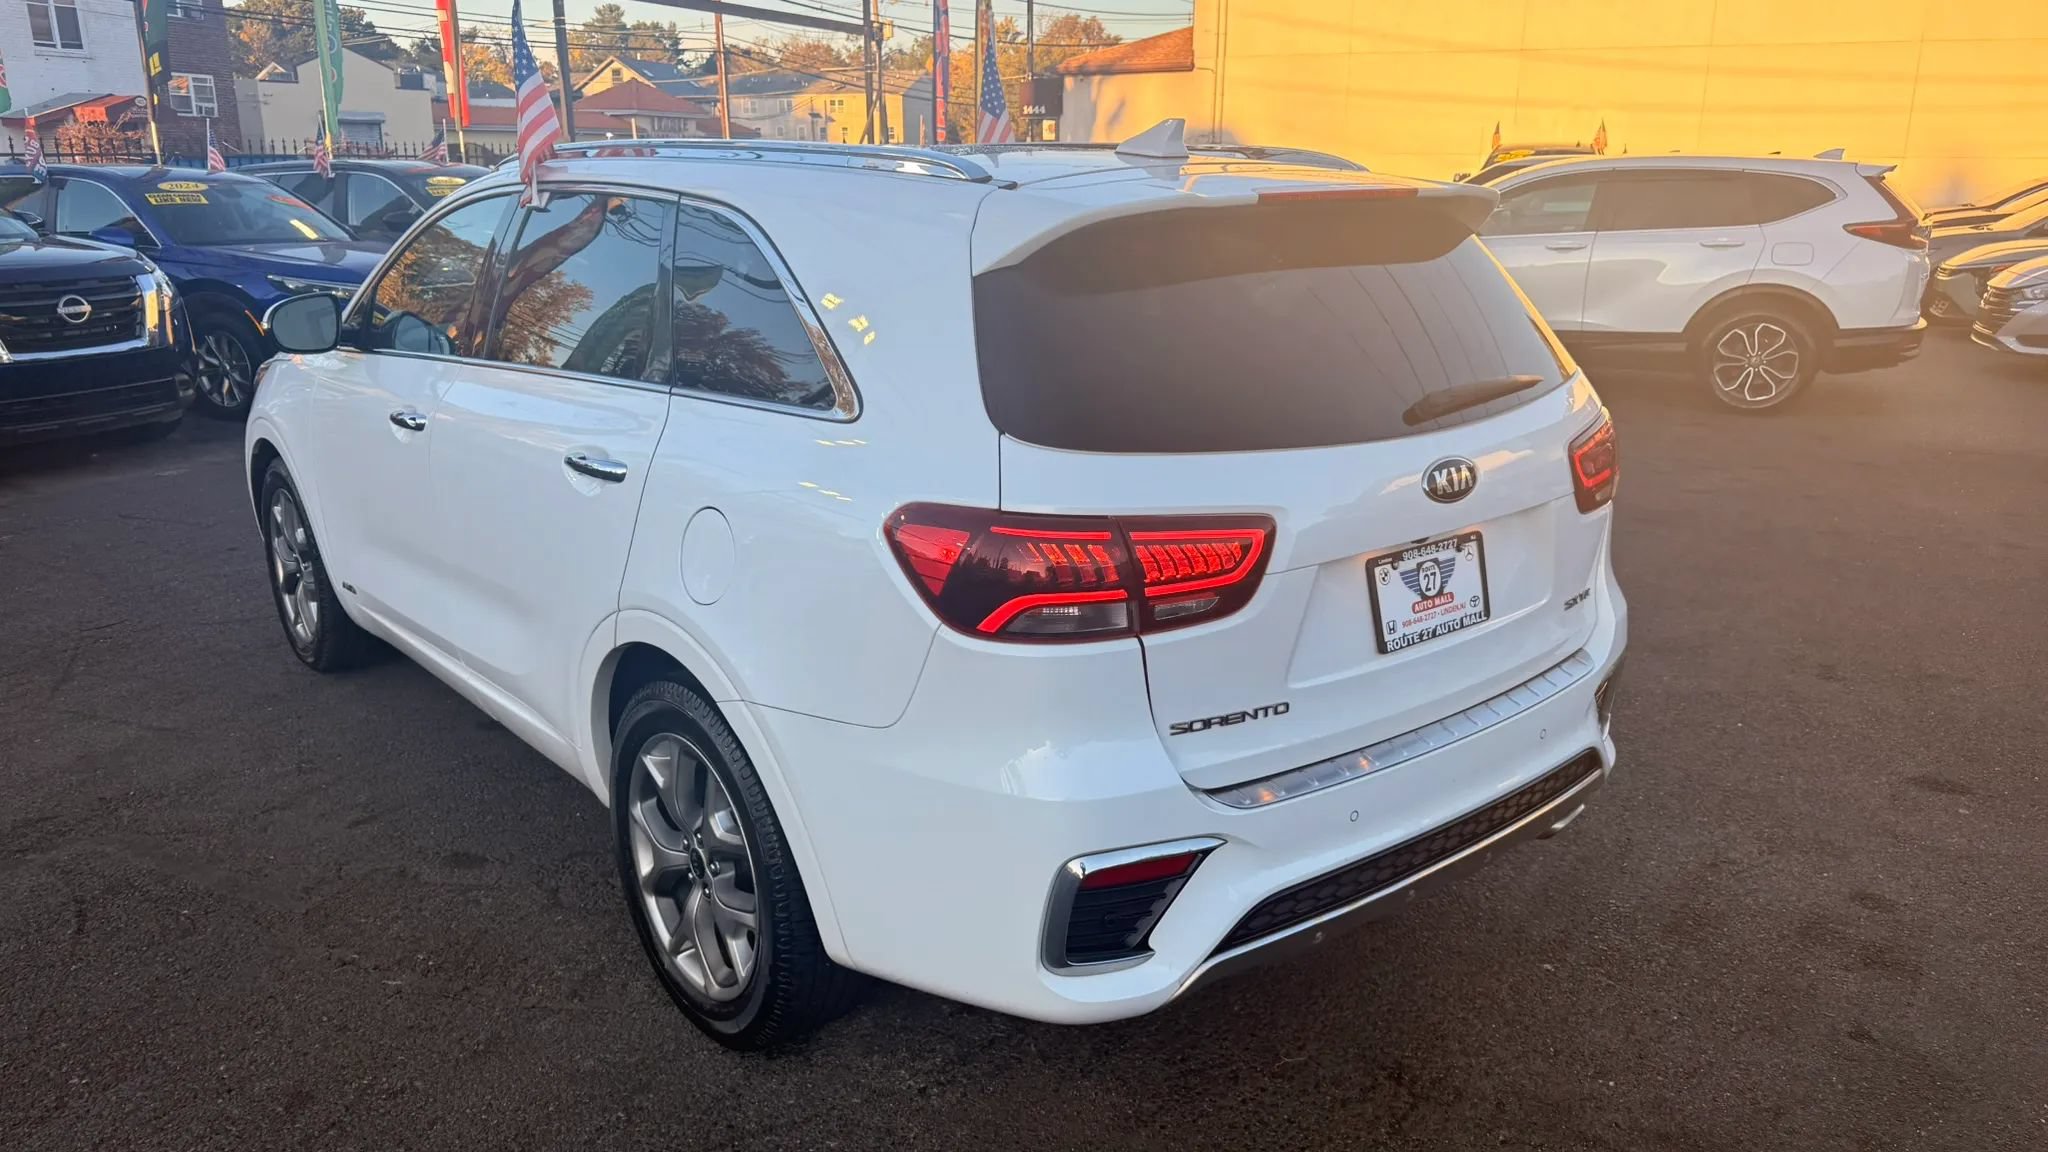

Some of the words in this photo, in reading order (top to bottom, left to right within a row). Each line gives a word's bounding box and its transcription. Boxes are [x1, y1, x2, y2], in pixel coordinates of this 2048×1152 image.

[1022, 104, 1046, 115] 1444
[1432, 464, 1473, 495] KIA
[1402, 539, 1458, 560] 908-648-2727
[1421, 565, 1436, 573] ROUTE
[1424, 572, 1437, 592] 27
[1414, 600, 1434, 613] AUTO
[1434, 593, 1453, 607] MALL
[1386, 632, 1421, 652] ROUTE
[1422, 628, 1433, 640] 27
[1436, 619, 1461, 636] AUTO
[1462, 611, 1488, 627] MALL
[1169, 702, 1290, 736] SORENTO
